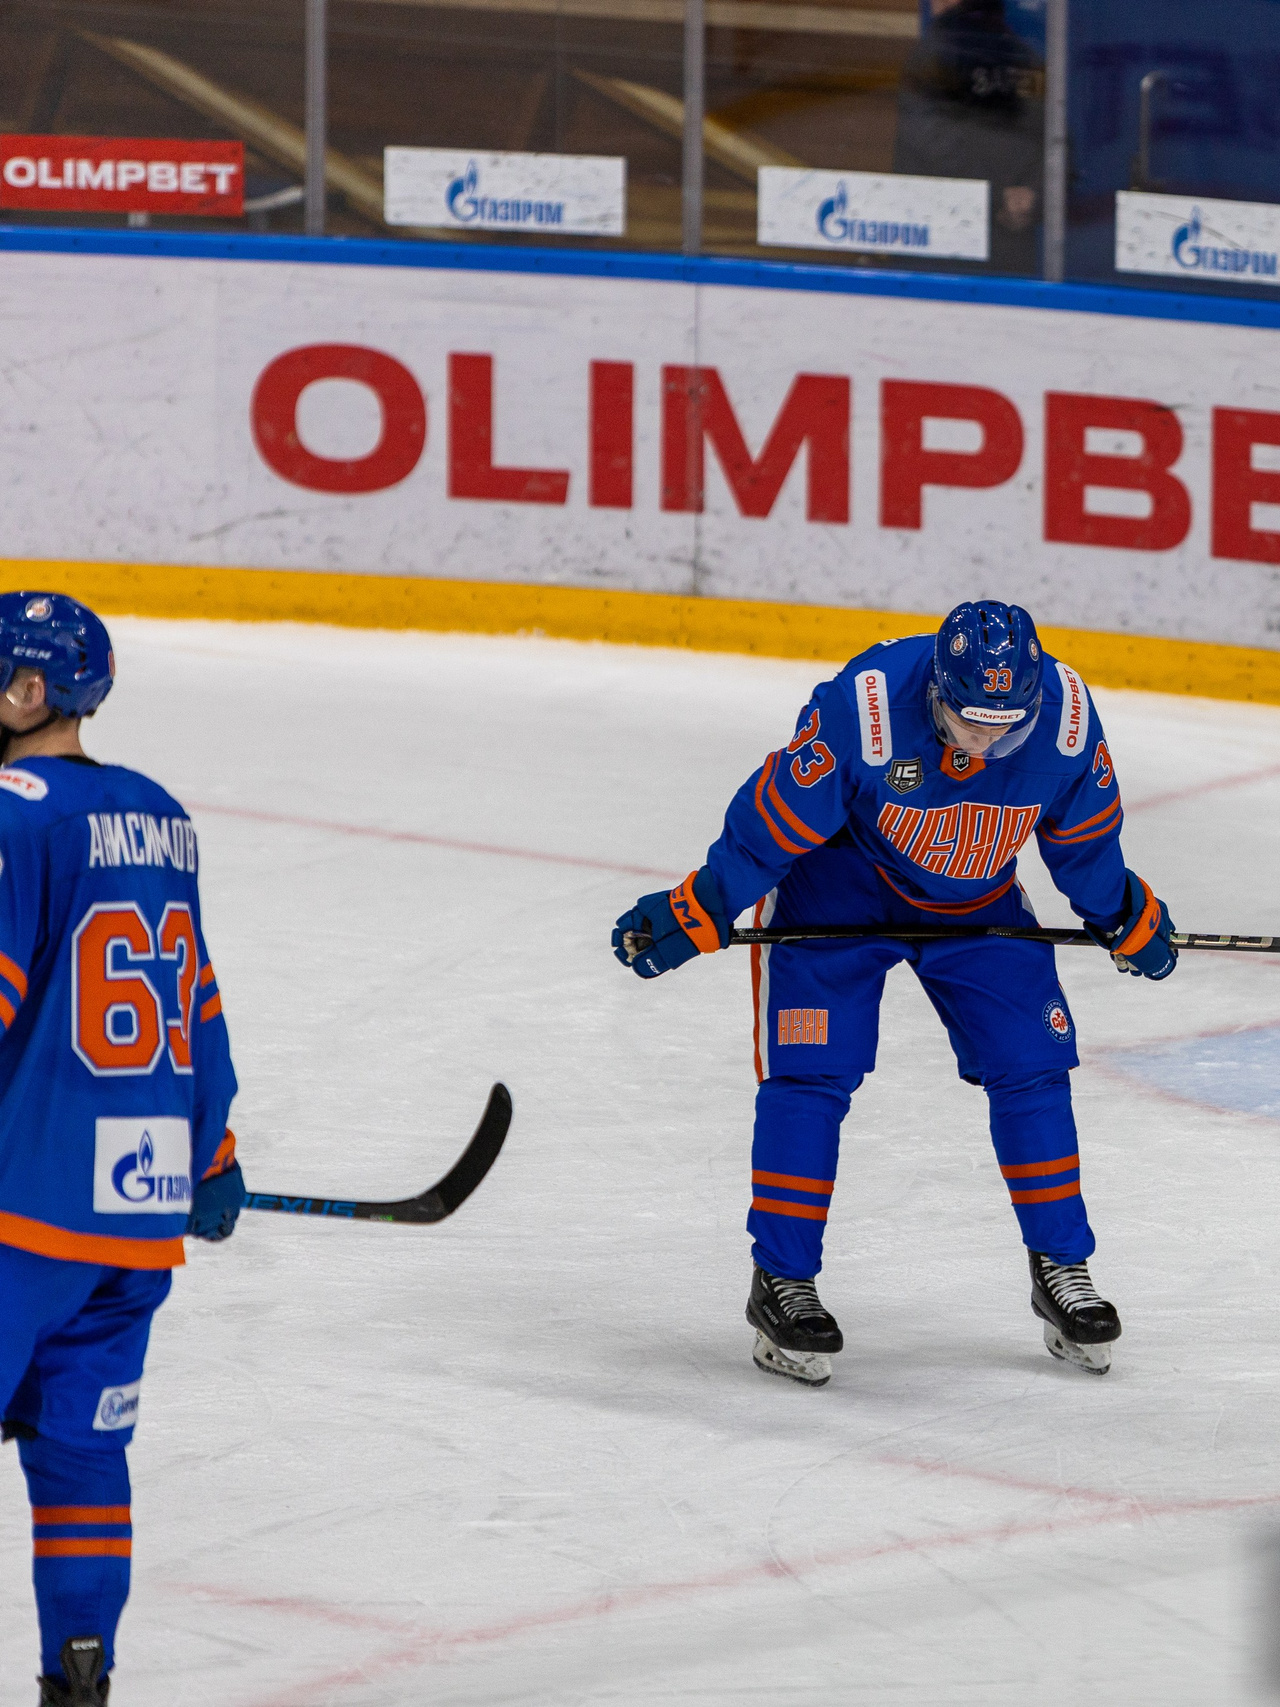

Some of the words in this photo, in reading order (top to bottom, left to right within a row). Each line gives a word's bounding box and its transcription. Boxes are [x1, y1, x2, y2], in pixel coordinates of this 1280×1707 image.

[3, 156, 237, 194] OLIMPBET
[965, 710, 1021, 720] OLIMPBET
[983, 668, 1013, 692] 33
[1064, 667, 1081, 748] OLIMPBET
[786, 708, 837, 788] 33
[865, 675, 883, 757] OLIMPBET
[87, 812, 196, 874] АНИСИМОВ
[877, 801, 1042, 880] НЕВА
[71, 901, 200, 1077] 63
[777, 1008, 829, 1045] НЕВА
